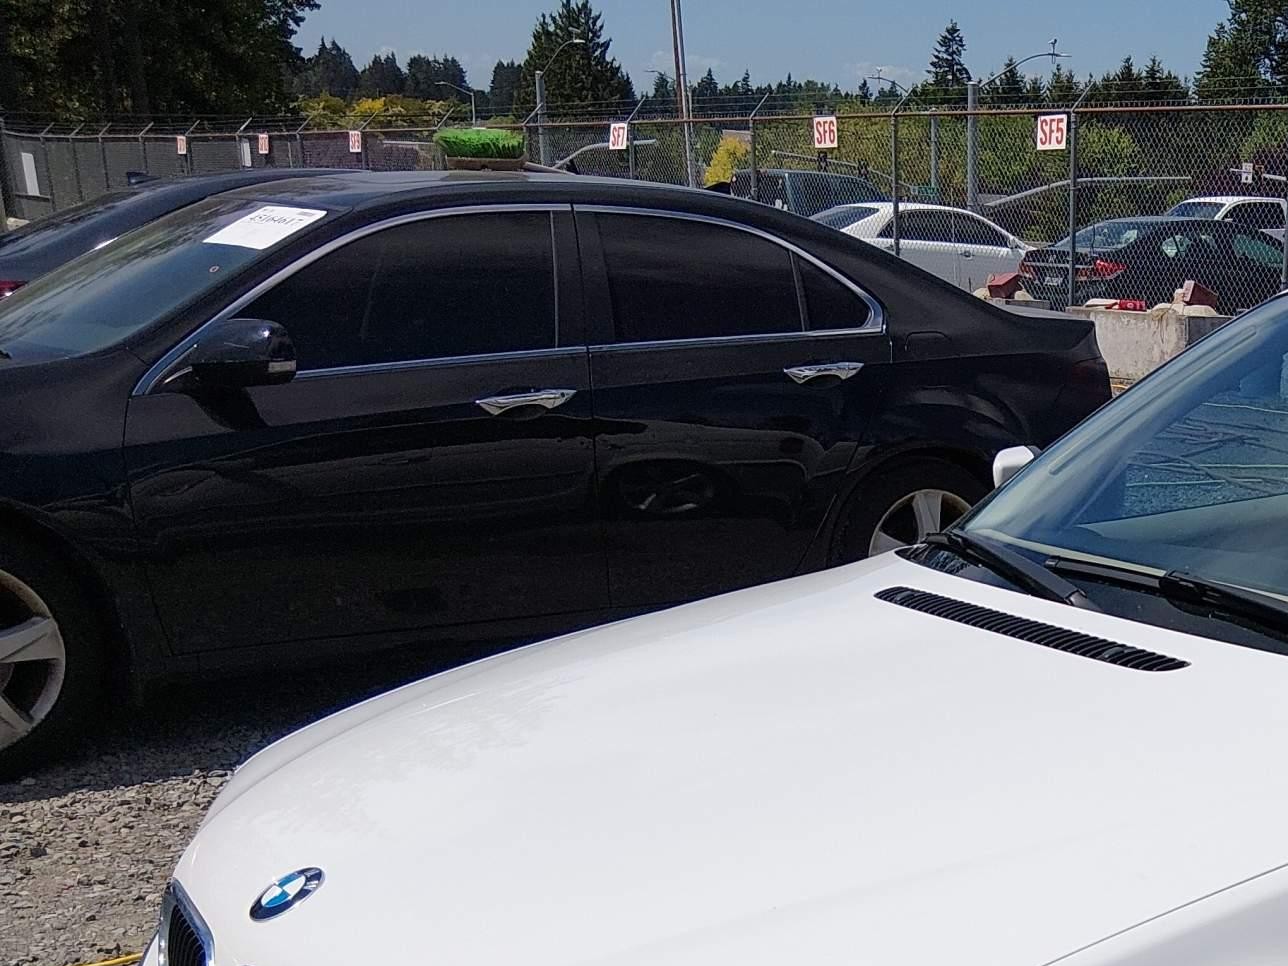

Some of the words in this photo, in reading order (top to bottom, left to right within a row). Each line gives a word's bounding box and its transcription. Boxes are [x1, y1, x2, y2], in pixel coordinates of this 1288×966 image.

[611, 126, 626, 147] SF7
[815, 120, 836, 145] SF6
[1039, 117, 1065, 145] SF5
